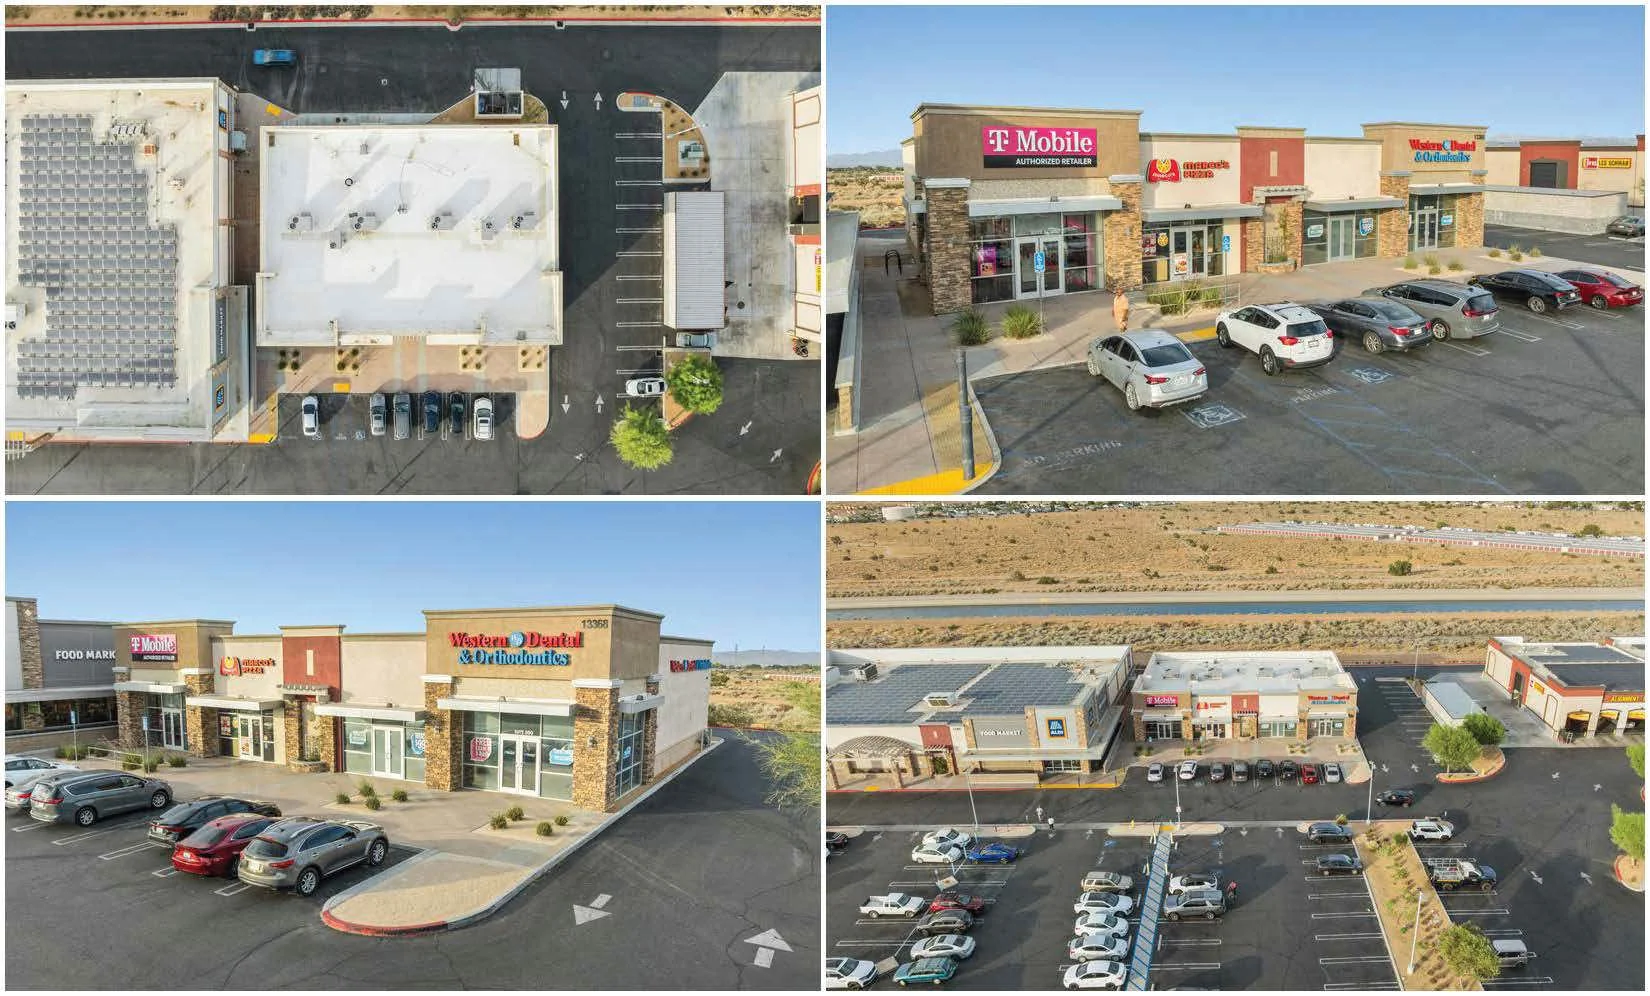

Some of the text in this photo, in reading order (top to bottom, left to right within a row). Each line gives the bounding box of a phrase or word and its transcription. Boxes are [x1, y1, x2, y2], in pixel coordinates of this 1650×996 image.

[989, 130, 1093, 153] T Mobile
[1015, 157, 1092, 166] AUTHORIZED RETAILER
[581, 619, 609, 629] 13368
[131, 637, 176, 651] T Mobile
[448, 632, 584, 648] Western Dental
[55, 650, 116, 660] FOOD MARK
[458, 649, 571, 666] & Orthodontics
